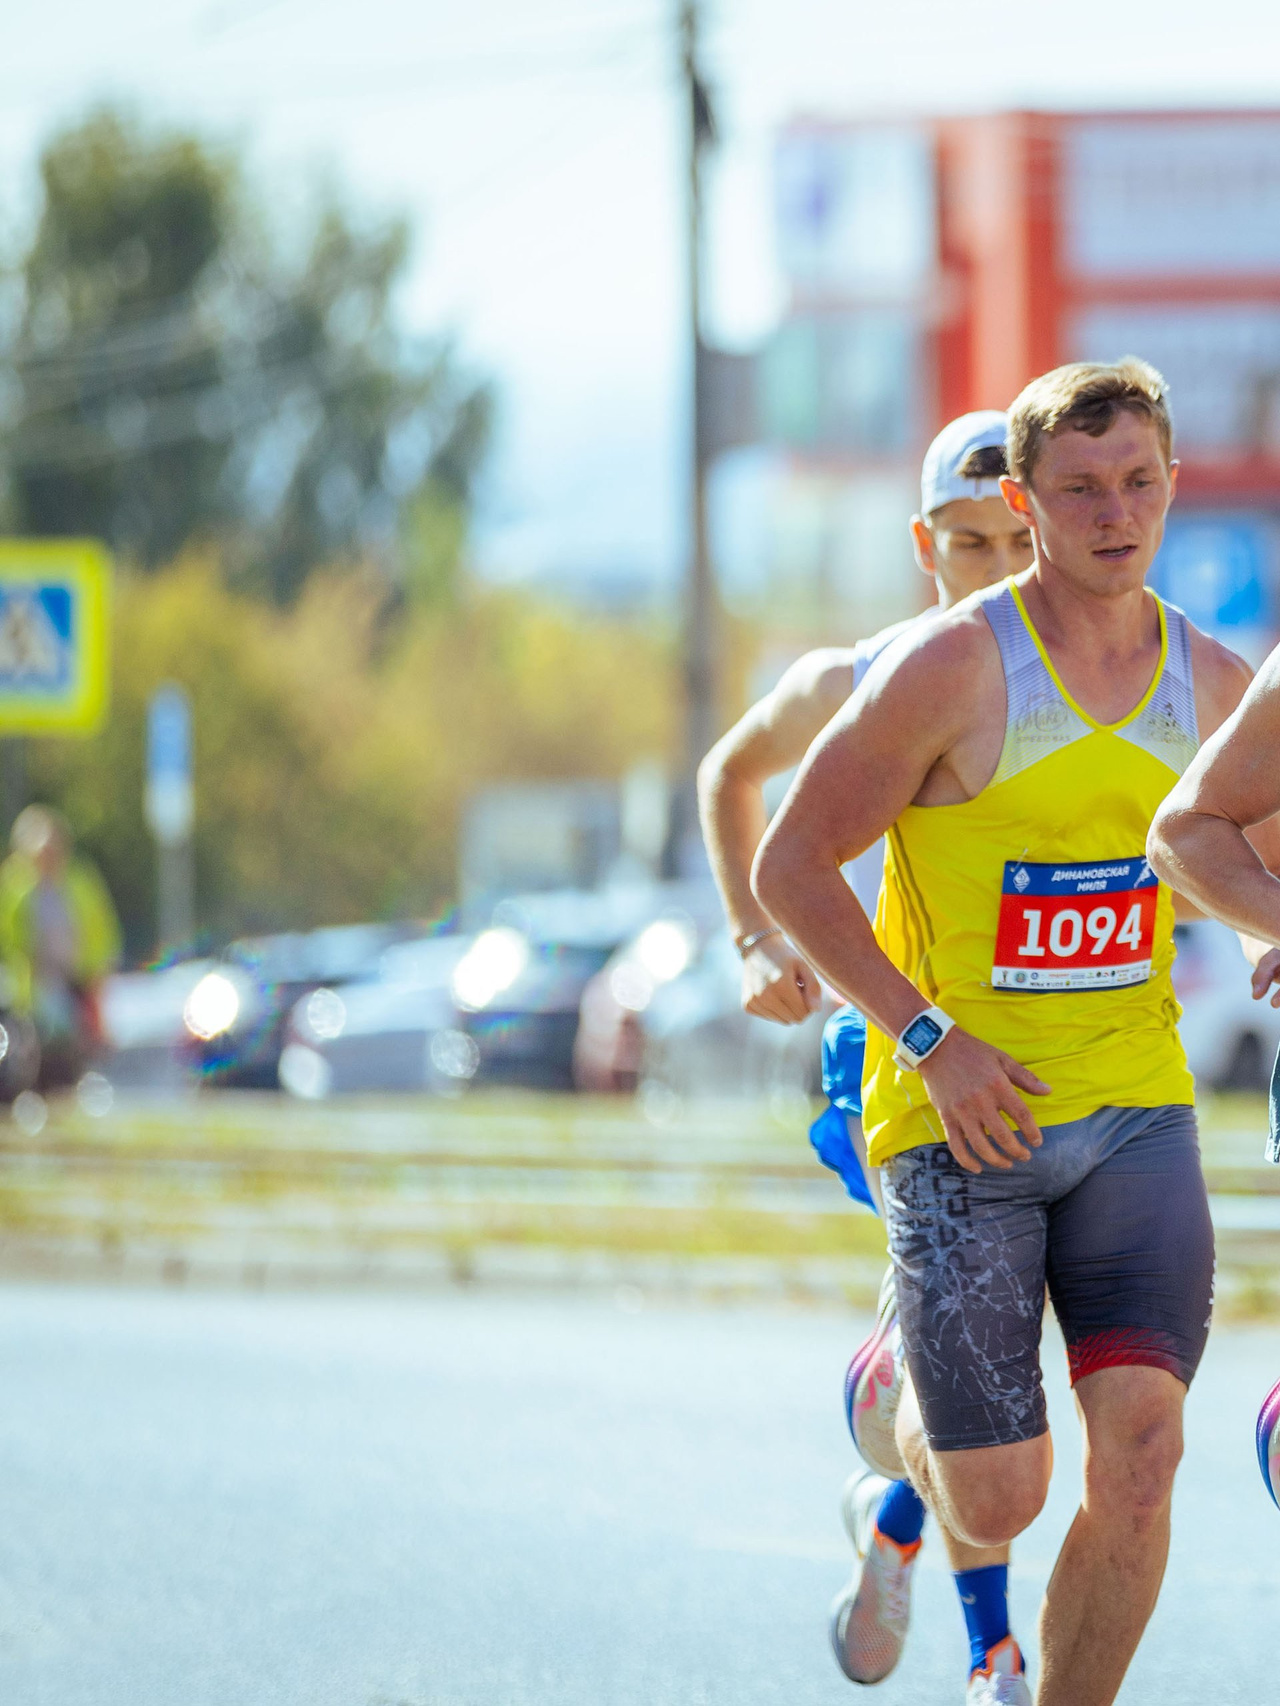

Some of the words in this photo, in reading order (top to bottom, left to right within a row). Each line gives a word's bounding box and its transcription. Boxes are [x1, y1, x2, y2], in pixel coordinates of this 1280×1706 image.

[1052, 866, 1130, 882] ДИНАМОВСКАЯ
[1077, 881, 1107, 892] МИЛЯ
[1017, 903, 1142, 958] 1094
